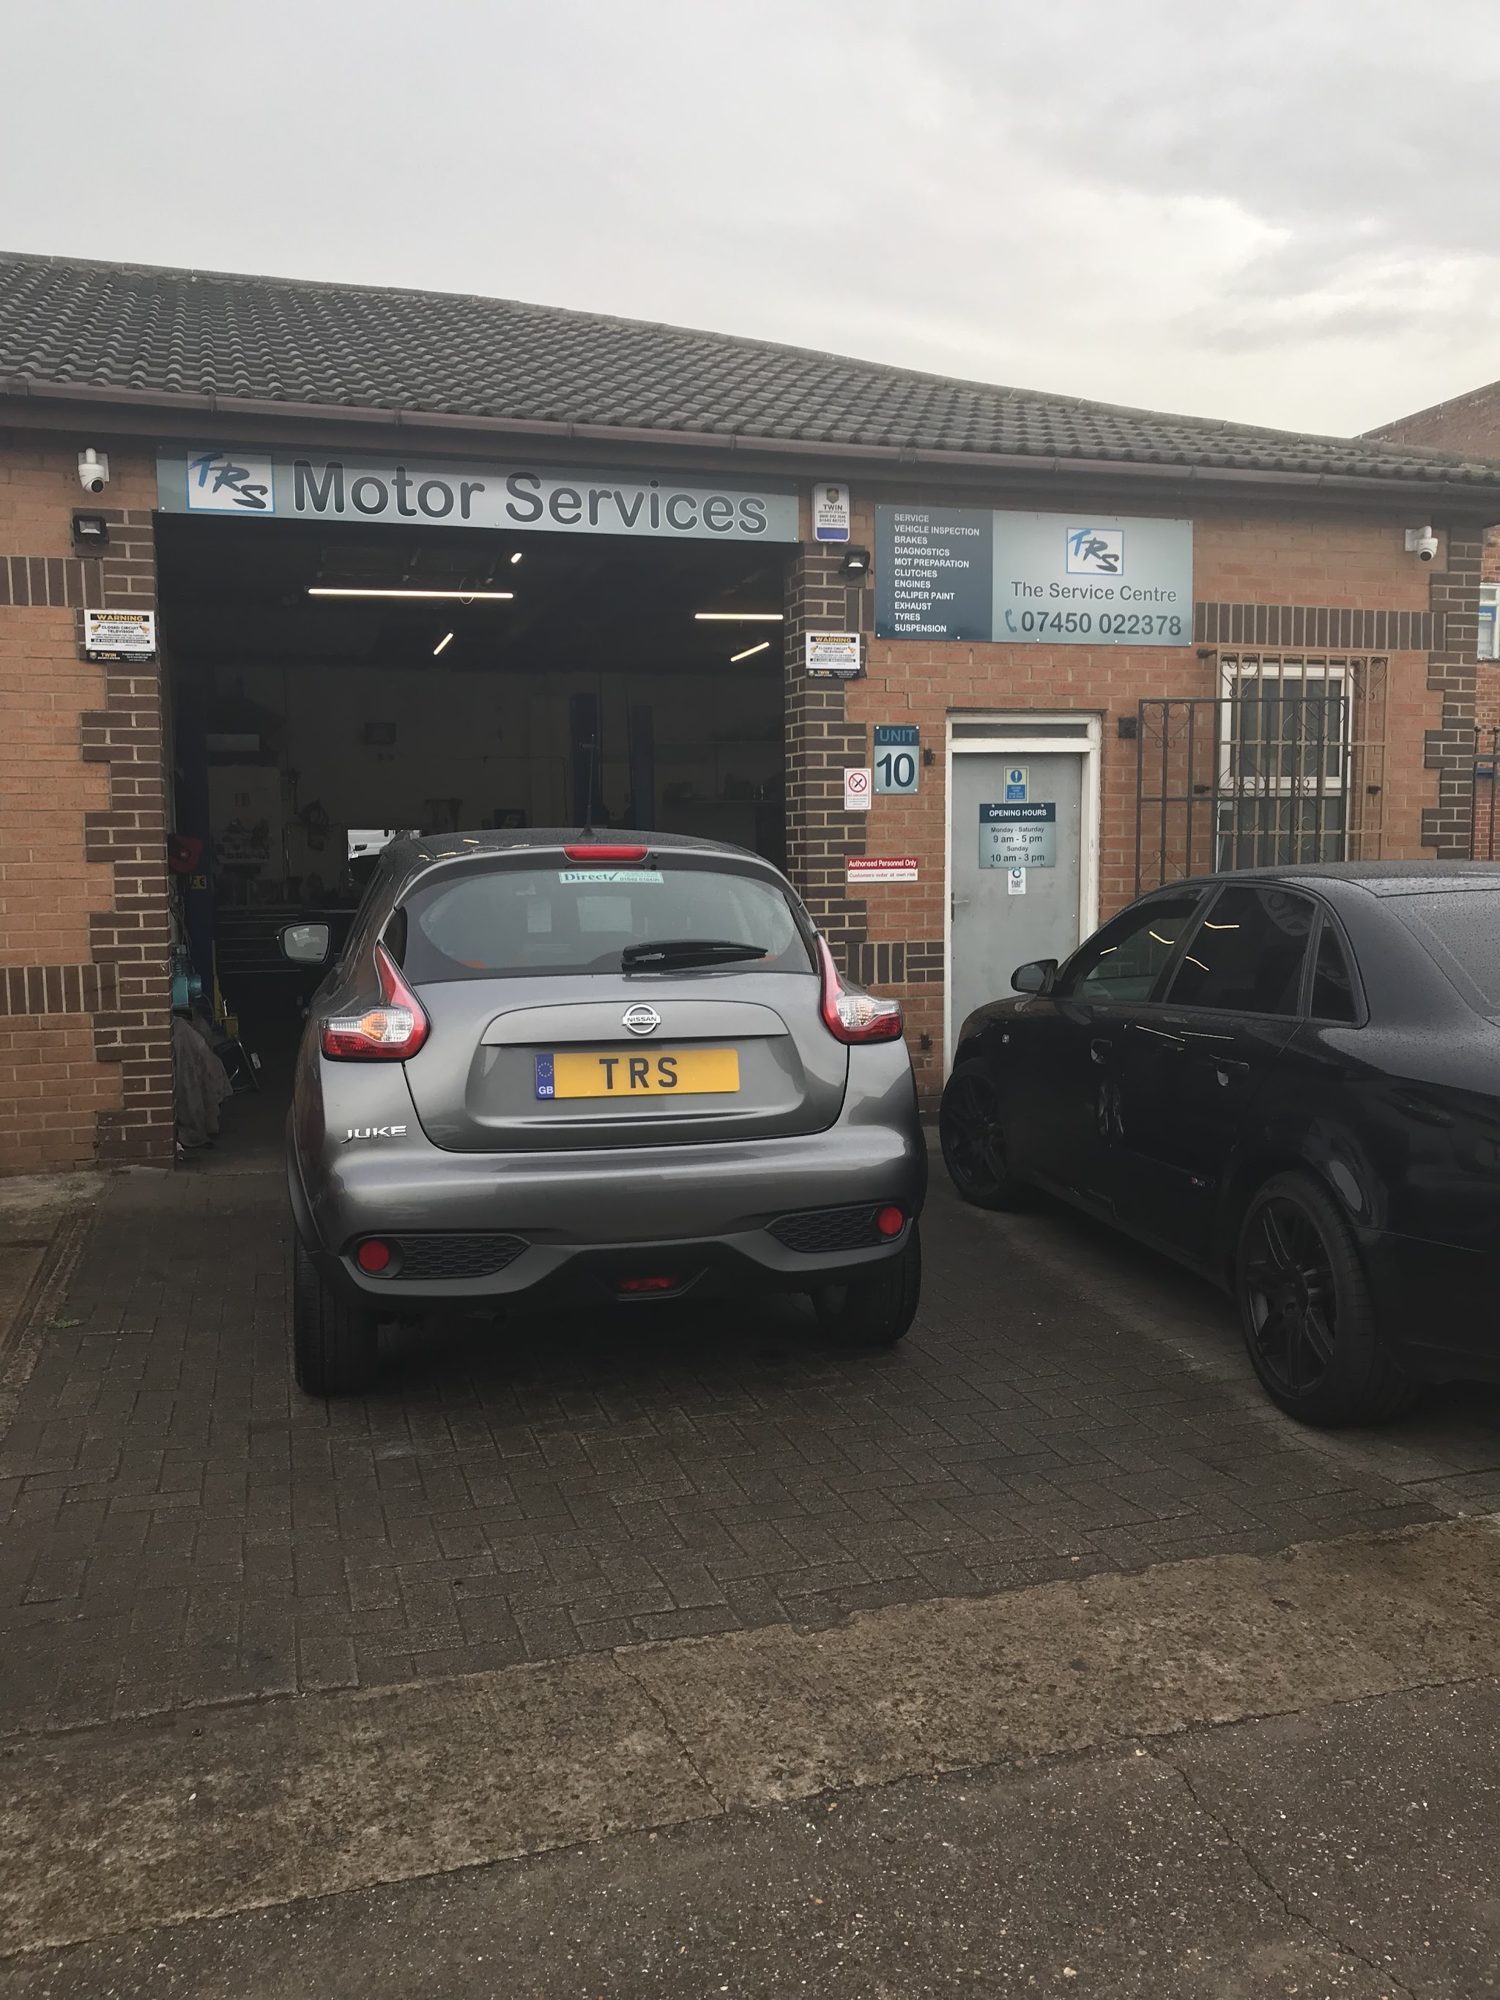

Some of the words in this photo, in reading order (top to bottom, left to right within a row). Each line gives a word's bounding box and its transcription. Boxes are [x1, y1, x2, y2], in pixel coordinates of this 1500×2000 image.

[189, 452, 269, 510] TRS
[292, 460, 485, 520] Motor
[504, 471, 768, 535] Services
[894, 513, 929, 522] SERVICE
[894, 525, 929, 534] VEHICLE
[931, 526, 980, 536] INSPECTION
[894, 535, 928, 545] BRAKES
[894, 546, 950, 557] DIAGNOSTICS
[1068, 528, 1120, 573] TRS
[894, 557, 911, 566] MOT
[913, 558, 970, 568] PREPARATION
[894, 568, 938, 578] CLUTCHES
[894, 579, 931, 588] ENGINES
[894, 590, 929, 599] CALIPER
[931, 592, 955, 600] PAINT
[1011, 581, 1043, 598] The
[1049, 582, 1114, 600] Service
[1119, 585, 1177, 602] Centre
[894, 601, 932, 610] EXHAUST
[96, 614, 144, 622] WARNING
[894, 612, 921, 621] TYRES
[894, 623, 947, 633] SUSPENSION
[1021, 611, 1092, 633] 07450
[1099, 613, 1182, 636] 022378
[879, 729, 915, 743] UNIT
[876, 752, 915, 788] 10
[989, 809, 1021, 817] OPENING
[993, 835, 999, 843] 9
[1021, 835, 1027, 843] 5
[1029, 836, 1043, 844] pm
[904, 859, 917, 867] Only
[990, 854, 1001, 862] 10
[1023, 853, 1029, 861] 3
[1031, 855, 1045, 863] pm
[564, 873, 608, 881] Direct
[626, 1015, 658, 1024] NISSAN
[599, 1056, 679, 1091] TRS
[538, 1085, 554, 1096] GB
[340, 1124, 408, 1145] JUKE
